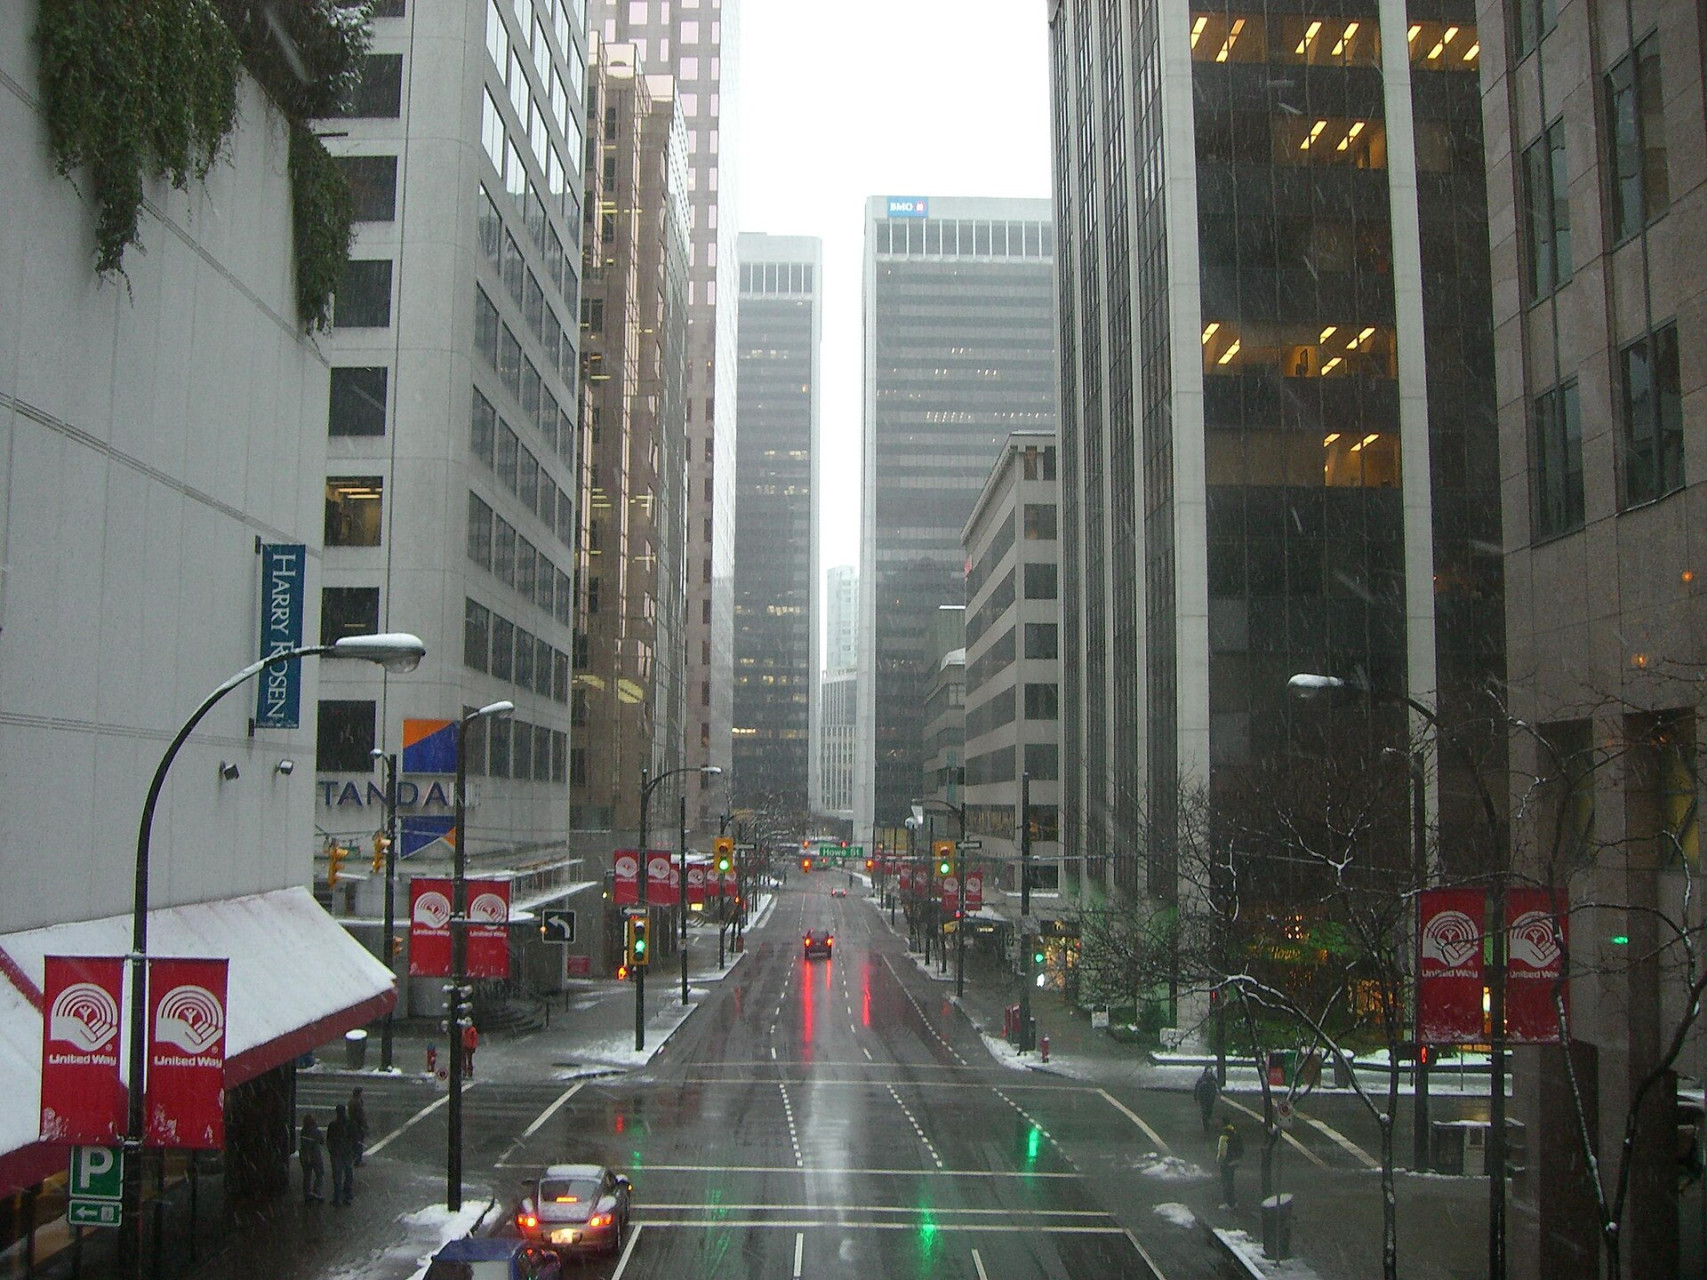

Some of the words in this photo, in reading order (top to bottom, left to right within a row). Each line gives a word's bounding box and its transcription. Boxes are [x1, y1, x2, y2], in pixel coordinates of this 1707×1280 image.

[890, 202, 913, 211] BMO
[271, 554, 296, 635] HARRY
[318, 781, 468, 807] TANDA
[823, 848, 847, 856] Howe
[1422, 968, 1455, 977] United
[1456, 970, 1479, 978] Way
[1509, 969, 1541, 978] United
[49, 1054, 91, 1065] United
[92, 1055, 117, 1067] Way
[154, 1055, 196, 1066] United
[197, 1056, 222, 1068] Way
[81, 1146, 114, 1189] P
